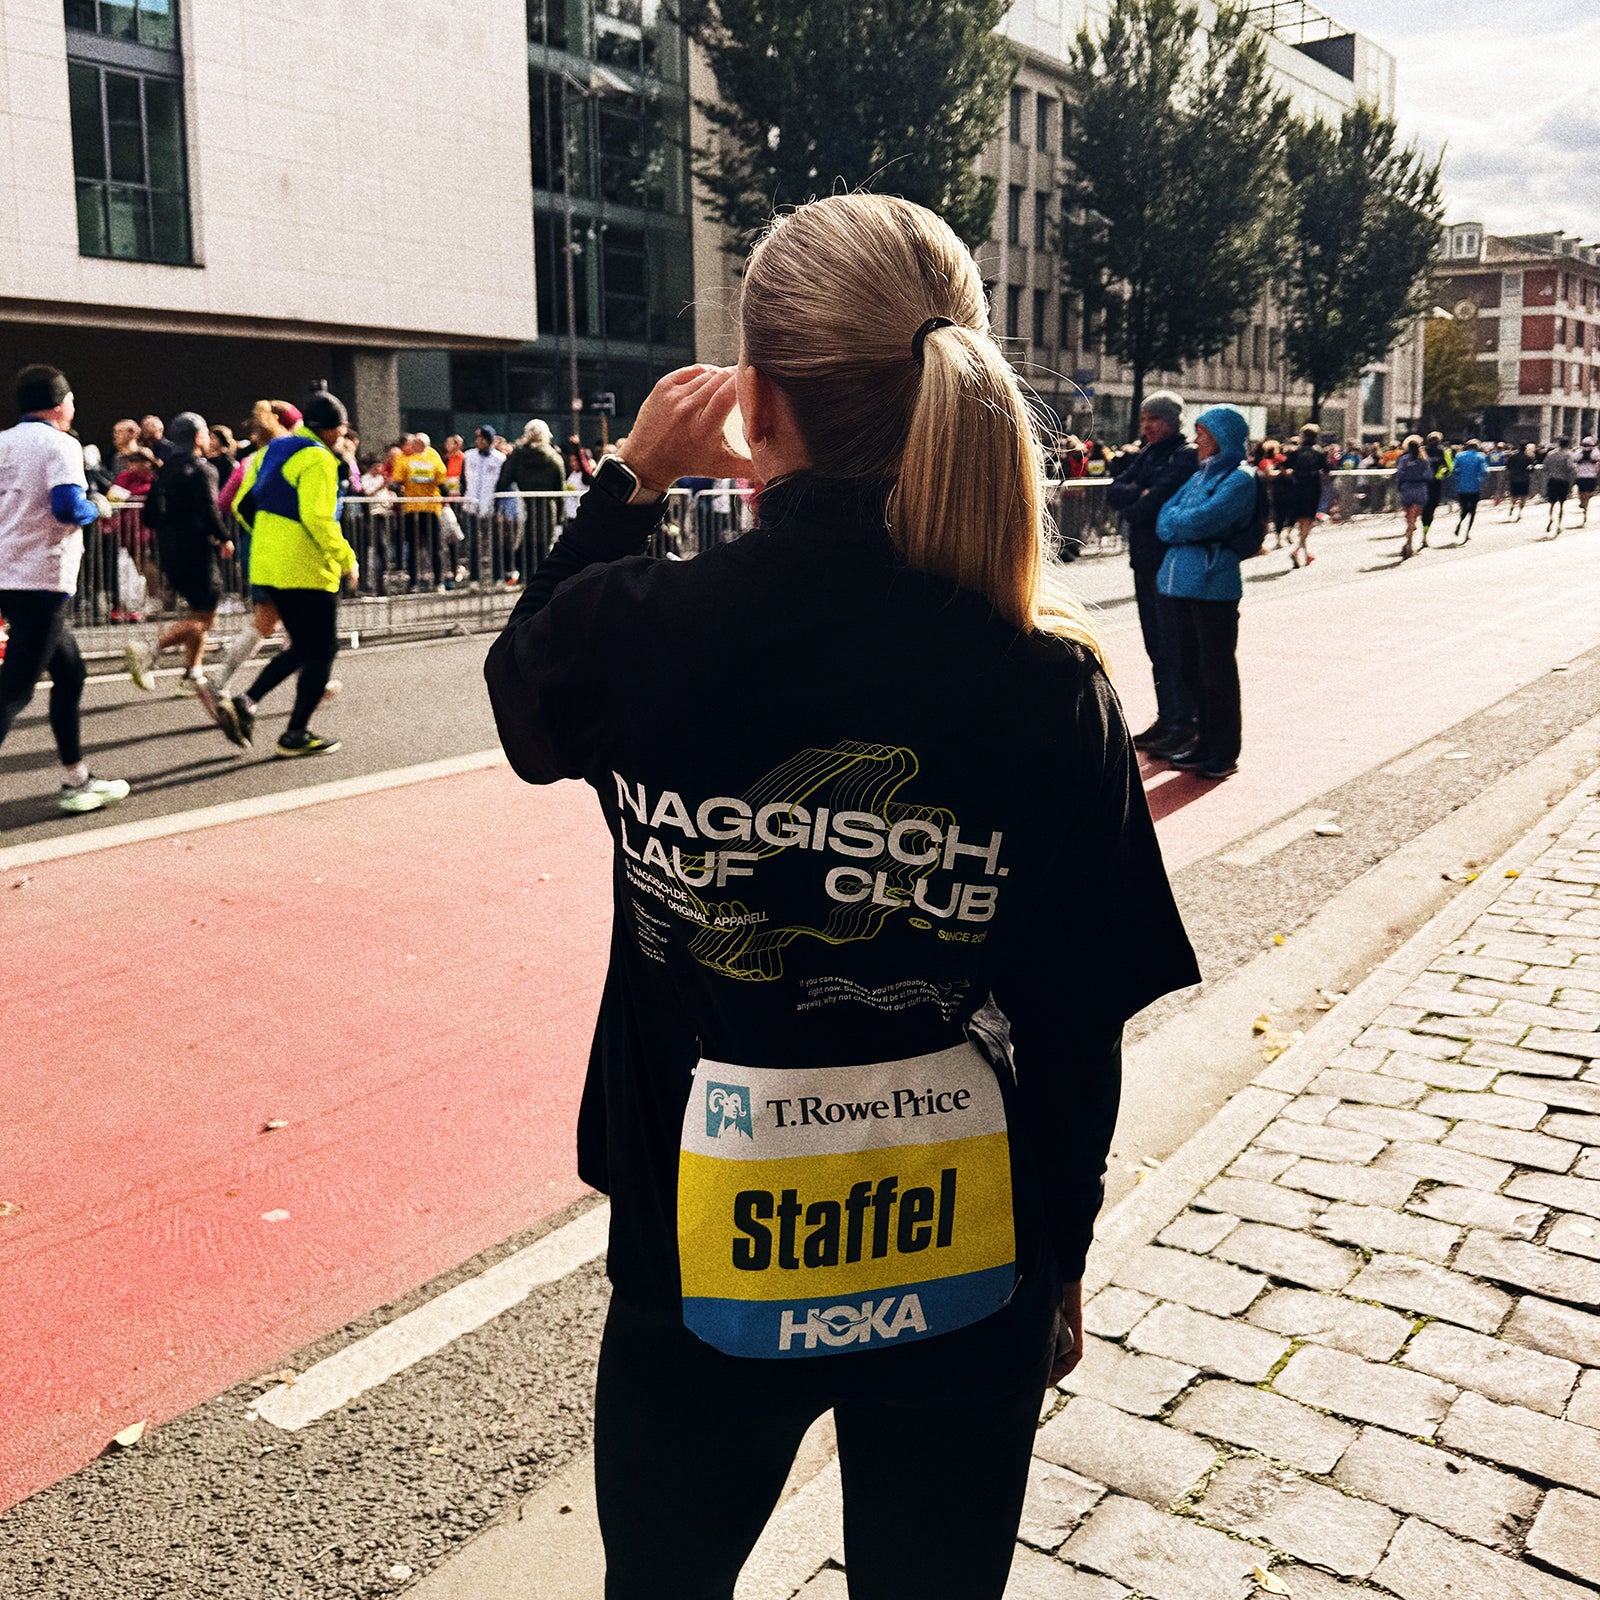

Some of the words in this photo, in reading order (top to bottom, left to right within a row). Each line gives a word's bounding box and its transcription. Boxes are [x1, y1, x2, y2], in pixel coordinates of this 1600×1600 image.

[612, 770, 1010, 876] NAGGISCH.
[620, 817, 758, 888] LAUF
[825, 866, 999, 922] CLUB
[667, 899, 710, 924] ORIGINAL
[713, 911, 769, 927] APPARELL
[937, 929, 970, 942] SINCE
[805, 978, 818, 987] you
[895, 980, 928, 990] probably
[893, 1003, 906, 1011] our
[732, 1167, 957, 1271] Staffel
[778, 1293, 928, 1351] HOKA
